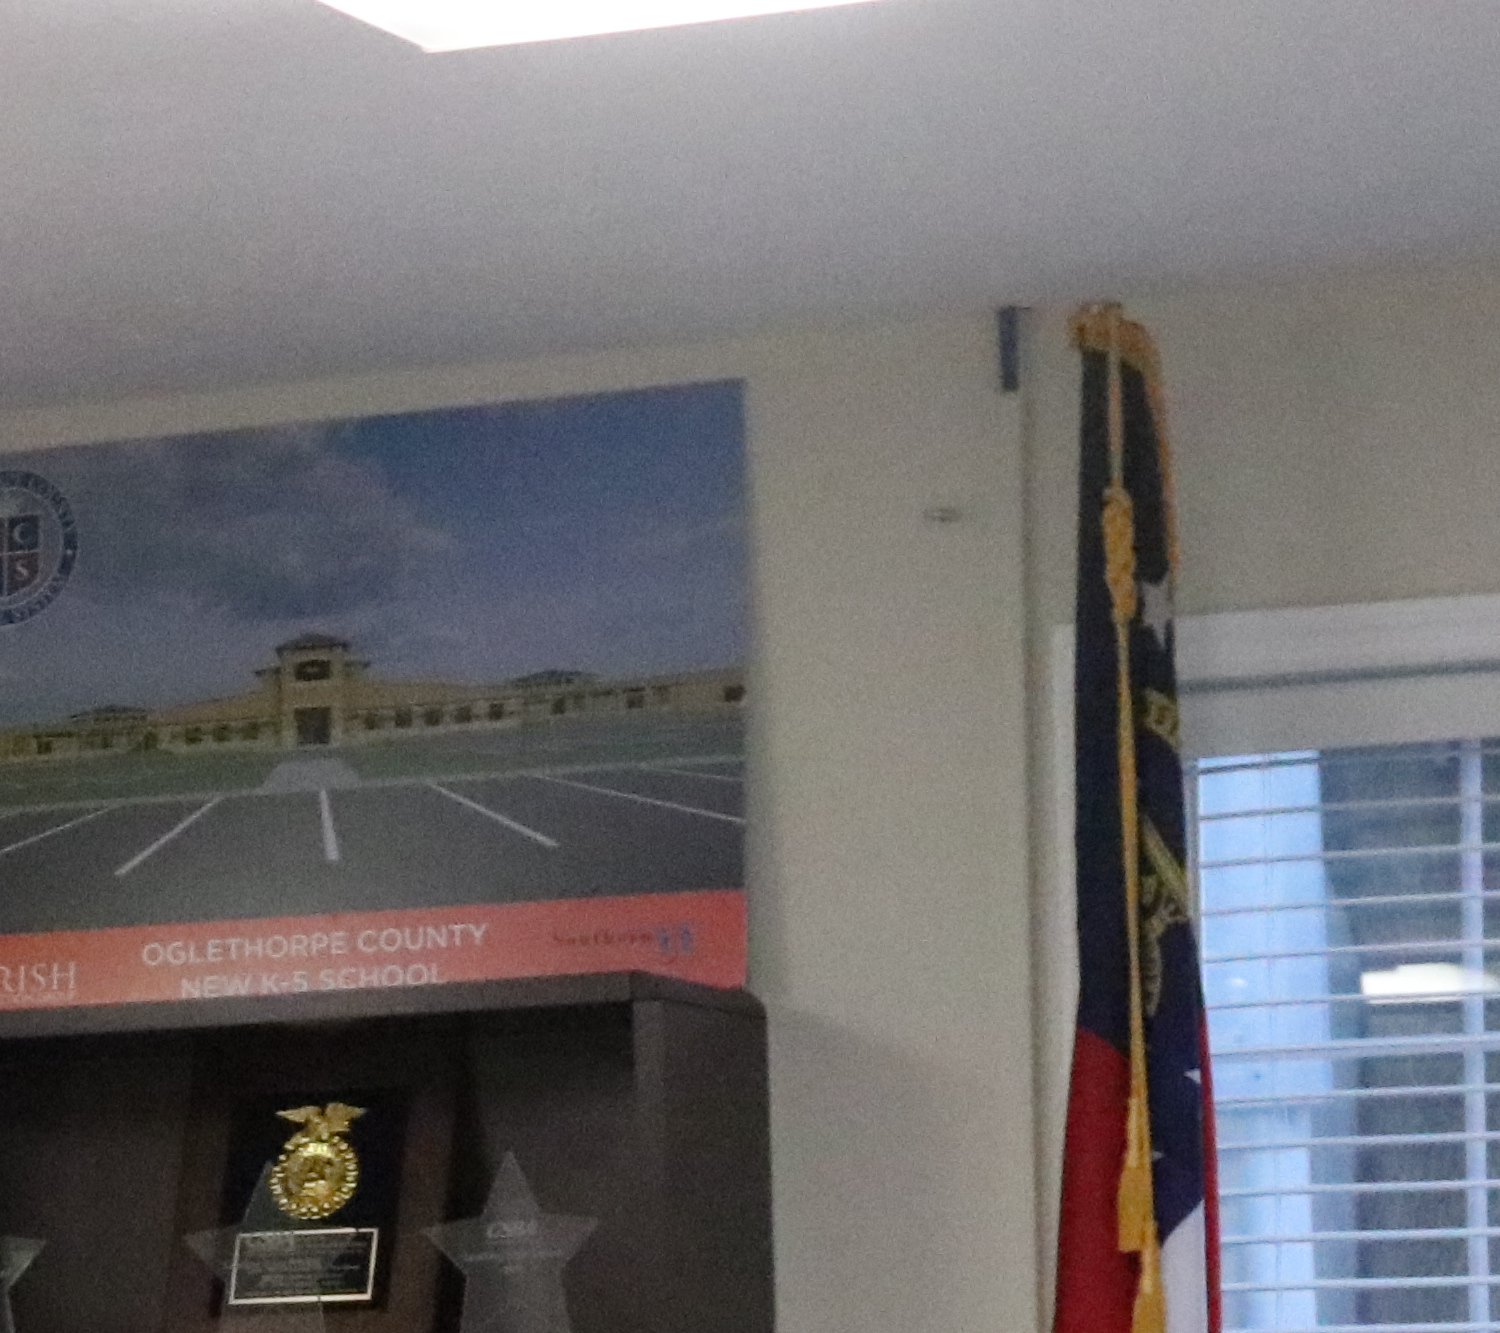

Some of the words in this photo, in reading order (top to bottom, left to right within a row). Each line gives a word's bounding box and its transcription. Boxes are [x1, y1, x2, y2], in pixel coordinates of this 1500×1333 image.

[141, 930, 347, 967] OGLETHORPE
[357, 923, 489, 954] COUNTY
[181, 974, 251, 999] NEW
[260, 971, 308, 996] K-5
[319, 963, 445, 991] SCHOOL
